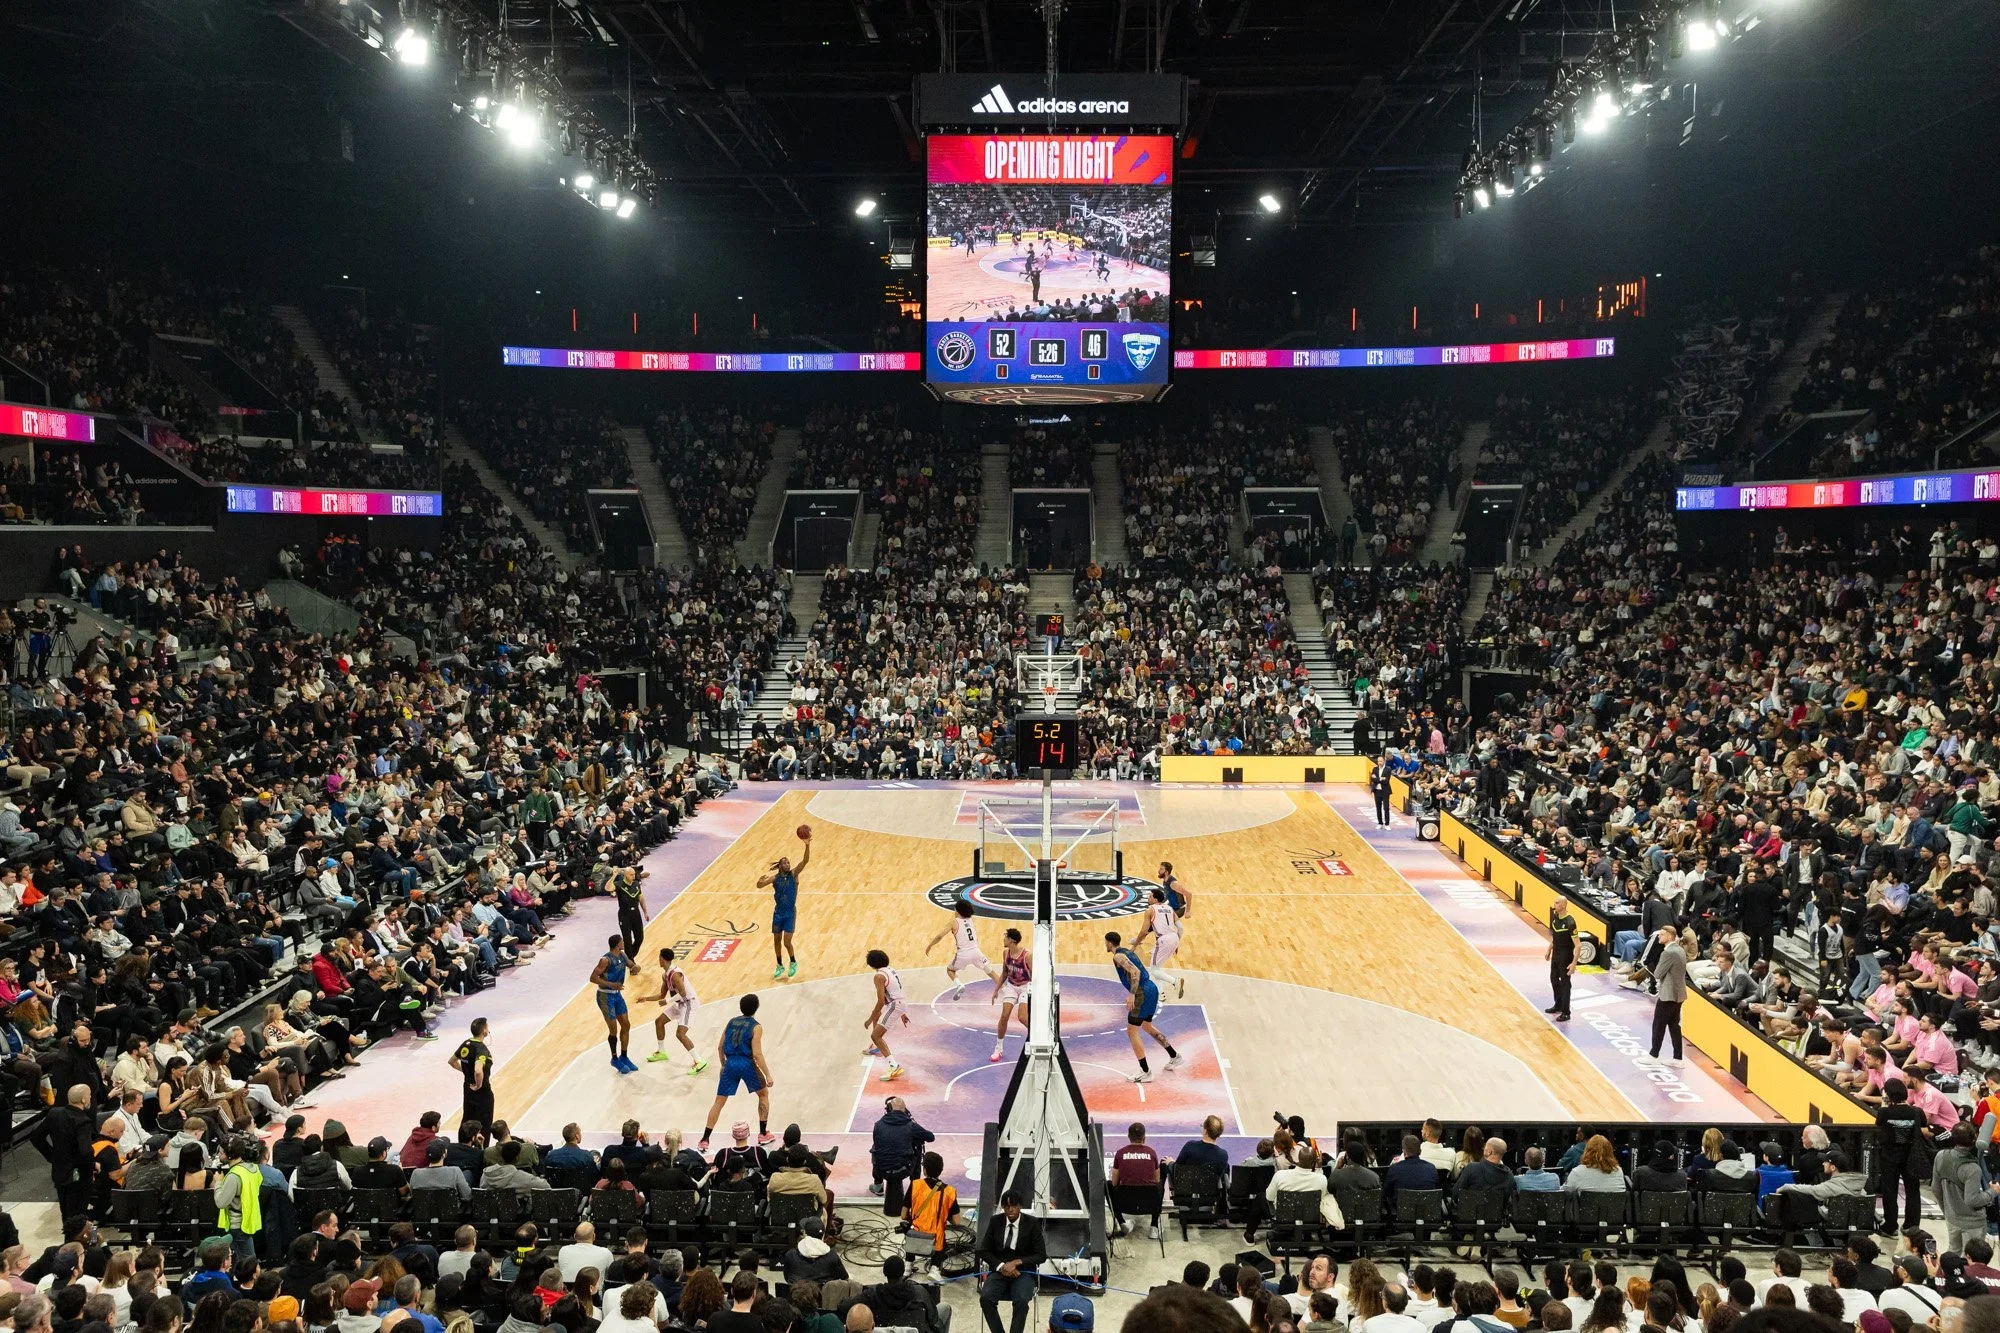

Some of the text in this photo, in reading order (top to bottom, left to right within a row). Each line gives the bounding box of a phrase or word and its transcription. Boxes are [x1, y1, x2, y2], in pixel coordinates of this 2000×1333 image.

[1018, 98, 1128, 114] adidas arena
[984, 140, 1116, 179] OPENING NIGHT
[996, 334, 1010, 356] 52
[1038, 343, 1058, 362] 5:26
[1088, 334, 1101, 356] 46
[1518, 344, 1535, 360] LET'S
[1596, 339, 1614, 356] LET'S
[568, 351, 584, 366] LET'S
[642, 354, 658, 368] LET'S
[716, 356, 732, 370] LET'S
[788, 356, 804, 370] LET'S
[860, 354, 875, 370] LET'S
[1220, 352, 1236, 367] LET'S
[1293, 351, 1310, 366] LET'S
[1367, 350, 1383, 365] LET'S
[1442, 348, 1458, 363] LET'S
[22, 410, 38, 434] LET'S
[322, 494, 338, 512] LET'S
[392, 496, 407, 514] LET'S
[1740, 488, 1756, 507] LET'S
[1044, 624, 1058, 636] 14
[1034, 723, 1061, 739] 5.2
[1040, 742, 1065, 764] 14
[1165, 914, 1170, 926] 1
[966, 928, 974, 942] 2
